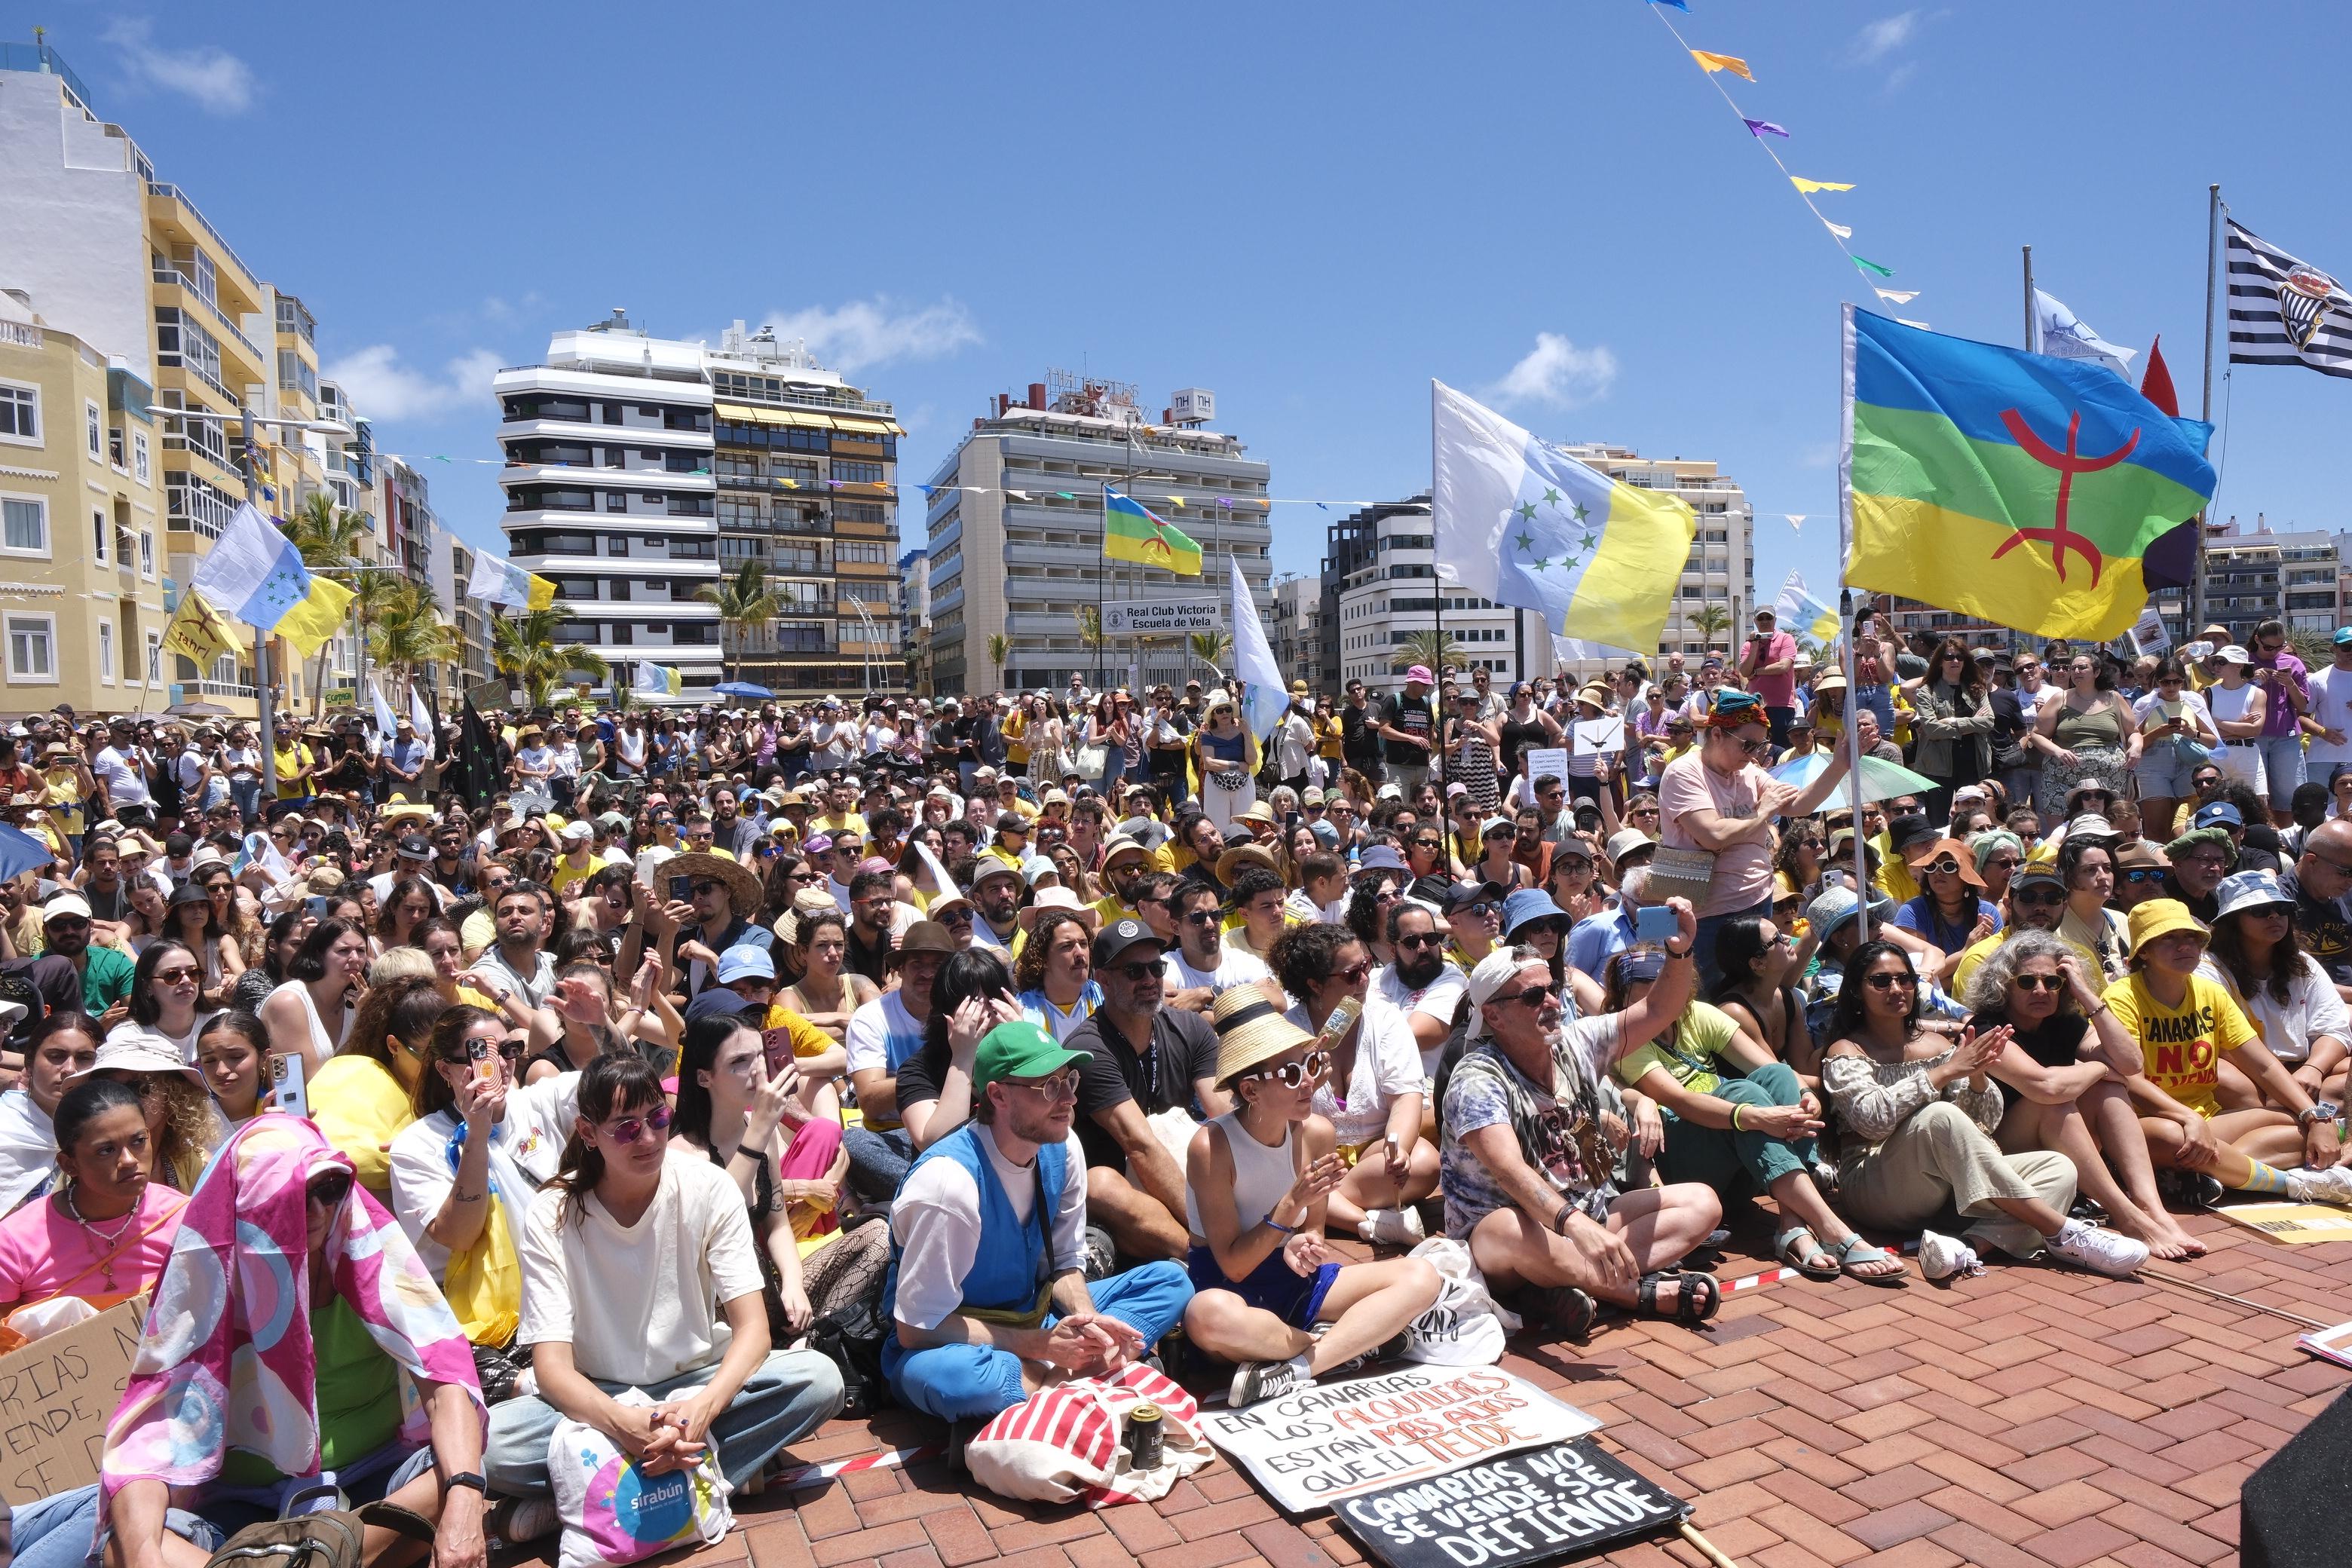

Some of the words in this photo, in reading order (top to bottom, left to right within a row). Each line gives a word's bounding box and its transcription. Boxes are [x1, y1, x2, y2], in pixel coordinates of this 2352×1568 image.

[1127, 607, 1149, 617] Real
[1152, 606, 1174, 616] Club
[1177, 605, 1216, 615] Victoria
[1132, 618, 1171, 629] Escuela
[1174, 617, 1187, 627] de
[1189, 617, 1211, 626] Vela
[2156, 1040, 2213, 1074] NO
[1214, 1412, 1266, 1435] EN
[1276, 1373, 1432, 1417] CANARIAS
[1264, 1418, 1334, 1441] LOS
[1332, 1371, 1510, 1431] ALQUILERES
[1264, 1435, 1377, 1475] ESTÁN
[1442, 1392, 1529, 1426] ALTOS
[1302, 1459, 1386, 1492] QUE
[1373, 1450, 1426, 1472] EL
[1402, 1416, 1542, 1464] TEIDE
[1346, 1461, 1530, 1527] CANARIAS
[1526, 1447, 1585, 1478] NO
[630, 1481, 683, 1510] sirabún
[1381, 1516, 1438, 1545] SE
[1554, 1465, 1616, 1496] SE
[1435, 1478, 1671, 1568] DEFIENDE
